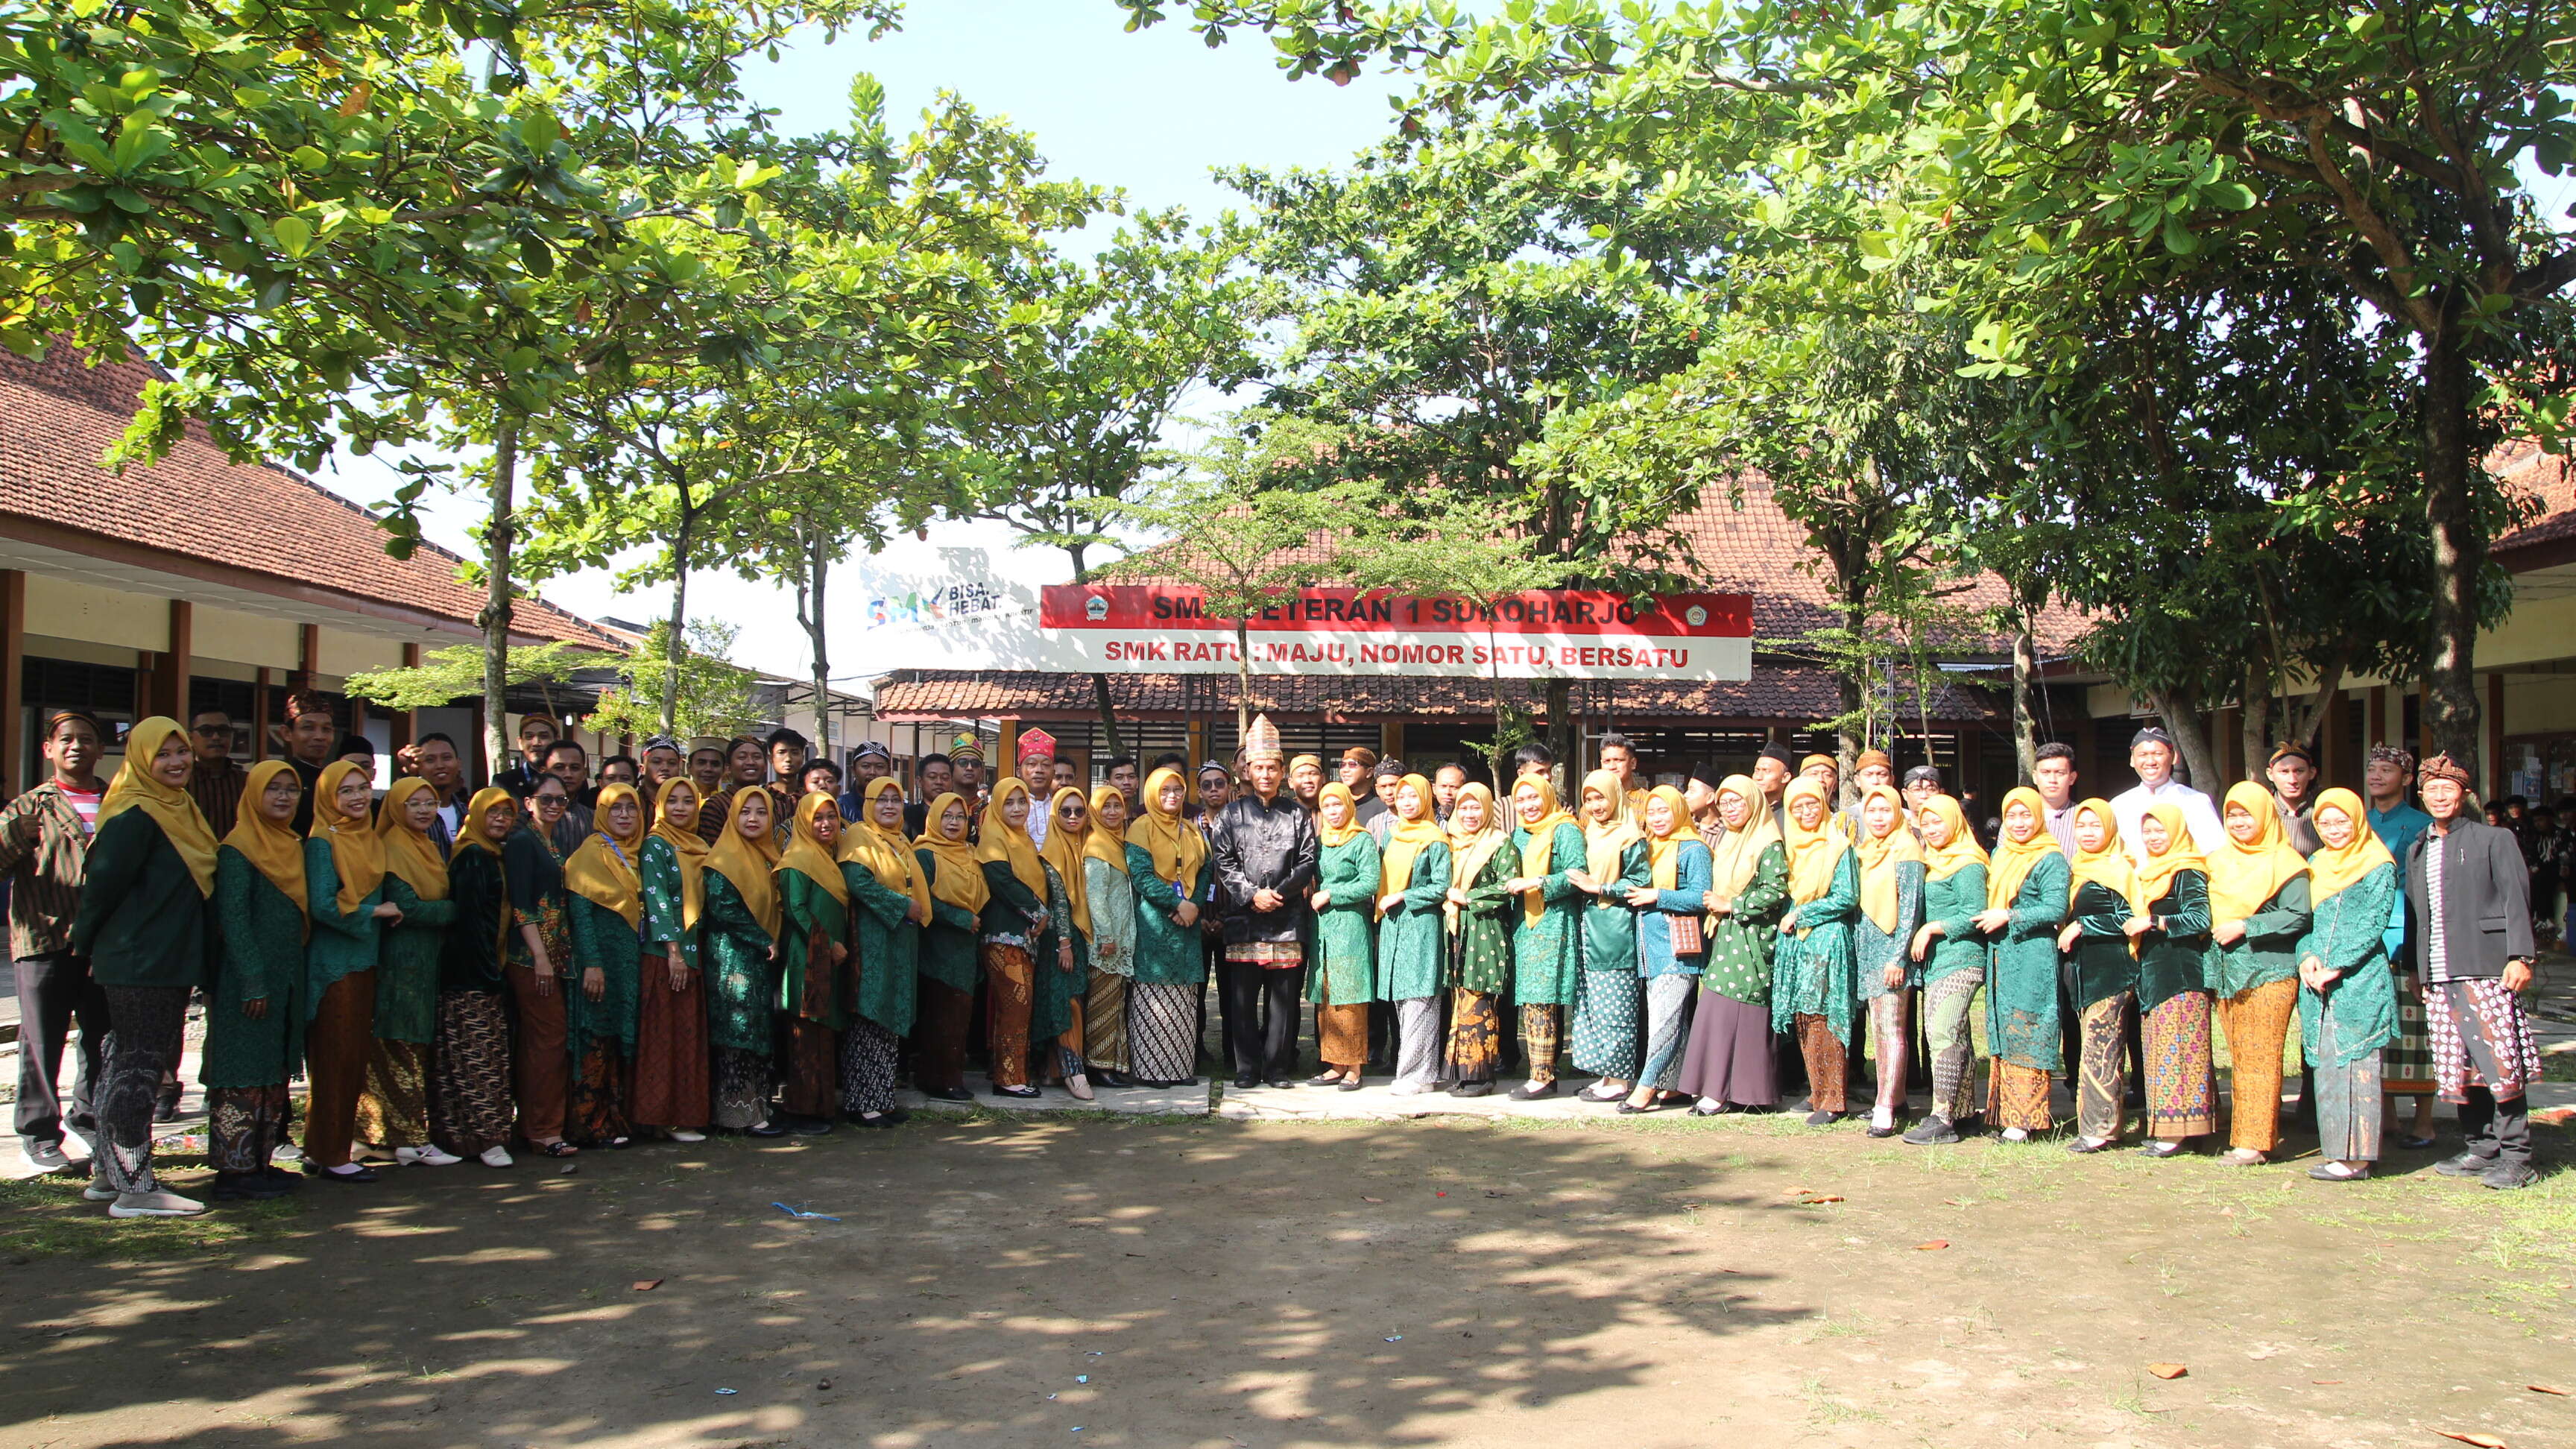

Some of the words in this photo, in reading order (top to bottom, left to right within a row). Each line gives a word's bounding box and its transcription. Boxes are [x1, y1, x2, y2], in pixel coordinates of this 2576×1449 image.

[949, 581, 989, 601] BISA.
[949, 595, 1002, 616] HEBAT.
[1154, 597, 1222, 619] SM
[1240, 597, 1391, 622] ETERAN
[1407, 599, 1418, 623] 1
[1432, 599, 1639, 625] SUKOHARJO
[1105, 641, 1167, 661] SMK
[1266, 643, 1354, 667] MAJU,
[1360, 645, 1464, 664] NOMOR
[1472, 645, 1554, 669] SATU,
[1561, 647, 1688, 668] BERSATU
